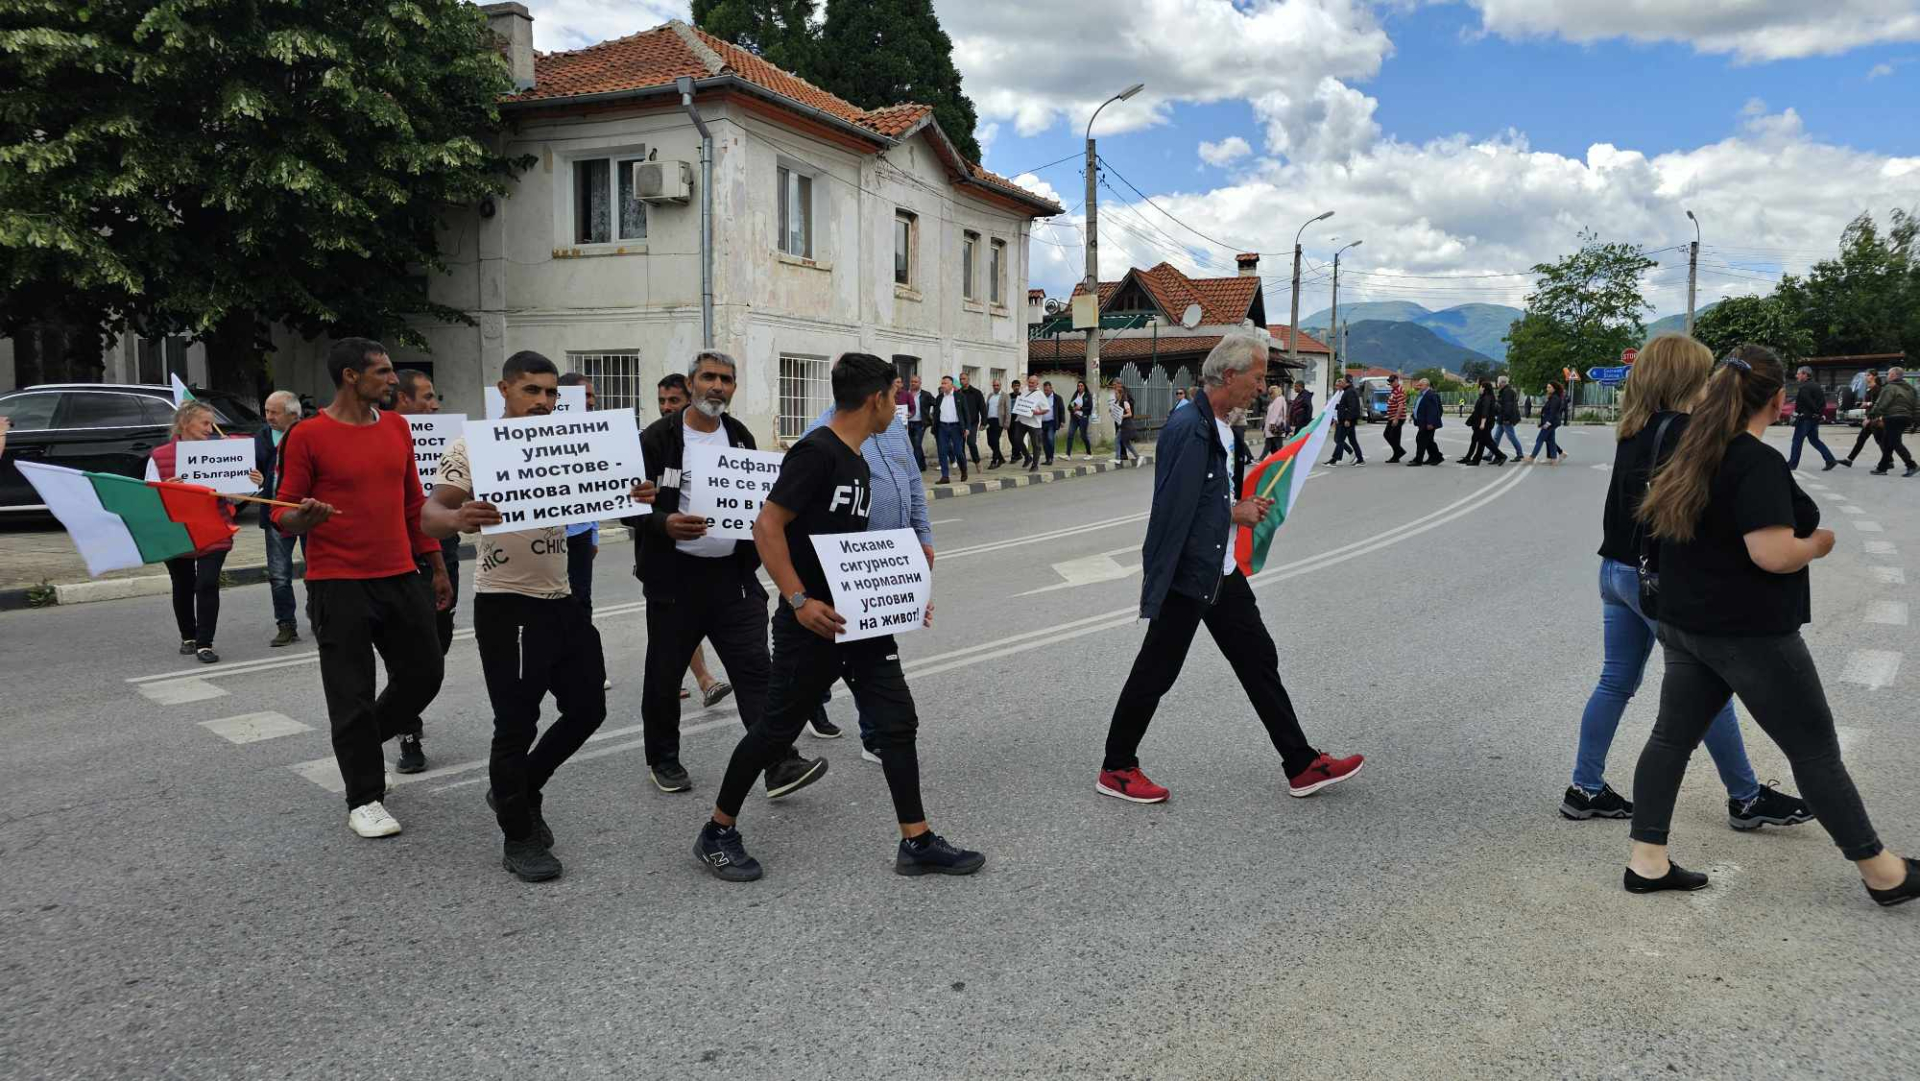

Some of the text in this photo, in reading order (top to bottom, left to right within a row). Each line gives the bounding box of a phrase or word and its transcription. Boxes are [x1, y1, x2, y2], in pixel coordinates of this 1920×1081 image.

[493, 420, 610, 442] Нормални
[188, 455, 243, 464] И Розино
[522, 442, 591, 462] улици
[496, 469, 510, 482] и
[518, 460, 609, 480] мостове
[479, 476, 642, 504] толкова много
[708, 476, 730, 488] не
[735, 479, 756, 490] се
[533, 495, 633, 520] искаме?!
[716, 497, 738, 509] но
[744, 500, 753, 510] в
[722, 518, 744, 529] се
[530, 538, 567, 555] CHIC
[840, 539, 895, 554] Искаме
[840, 555, 910, 573] сигурност
[841, 572, 922, 592] и нормални
[861, 592, 915, 613] условия
[859, 607, 920, 630] на живот!
